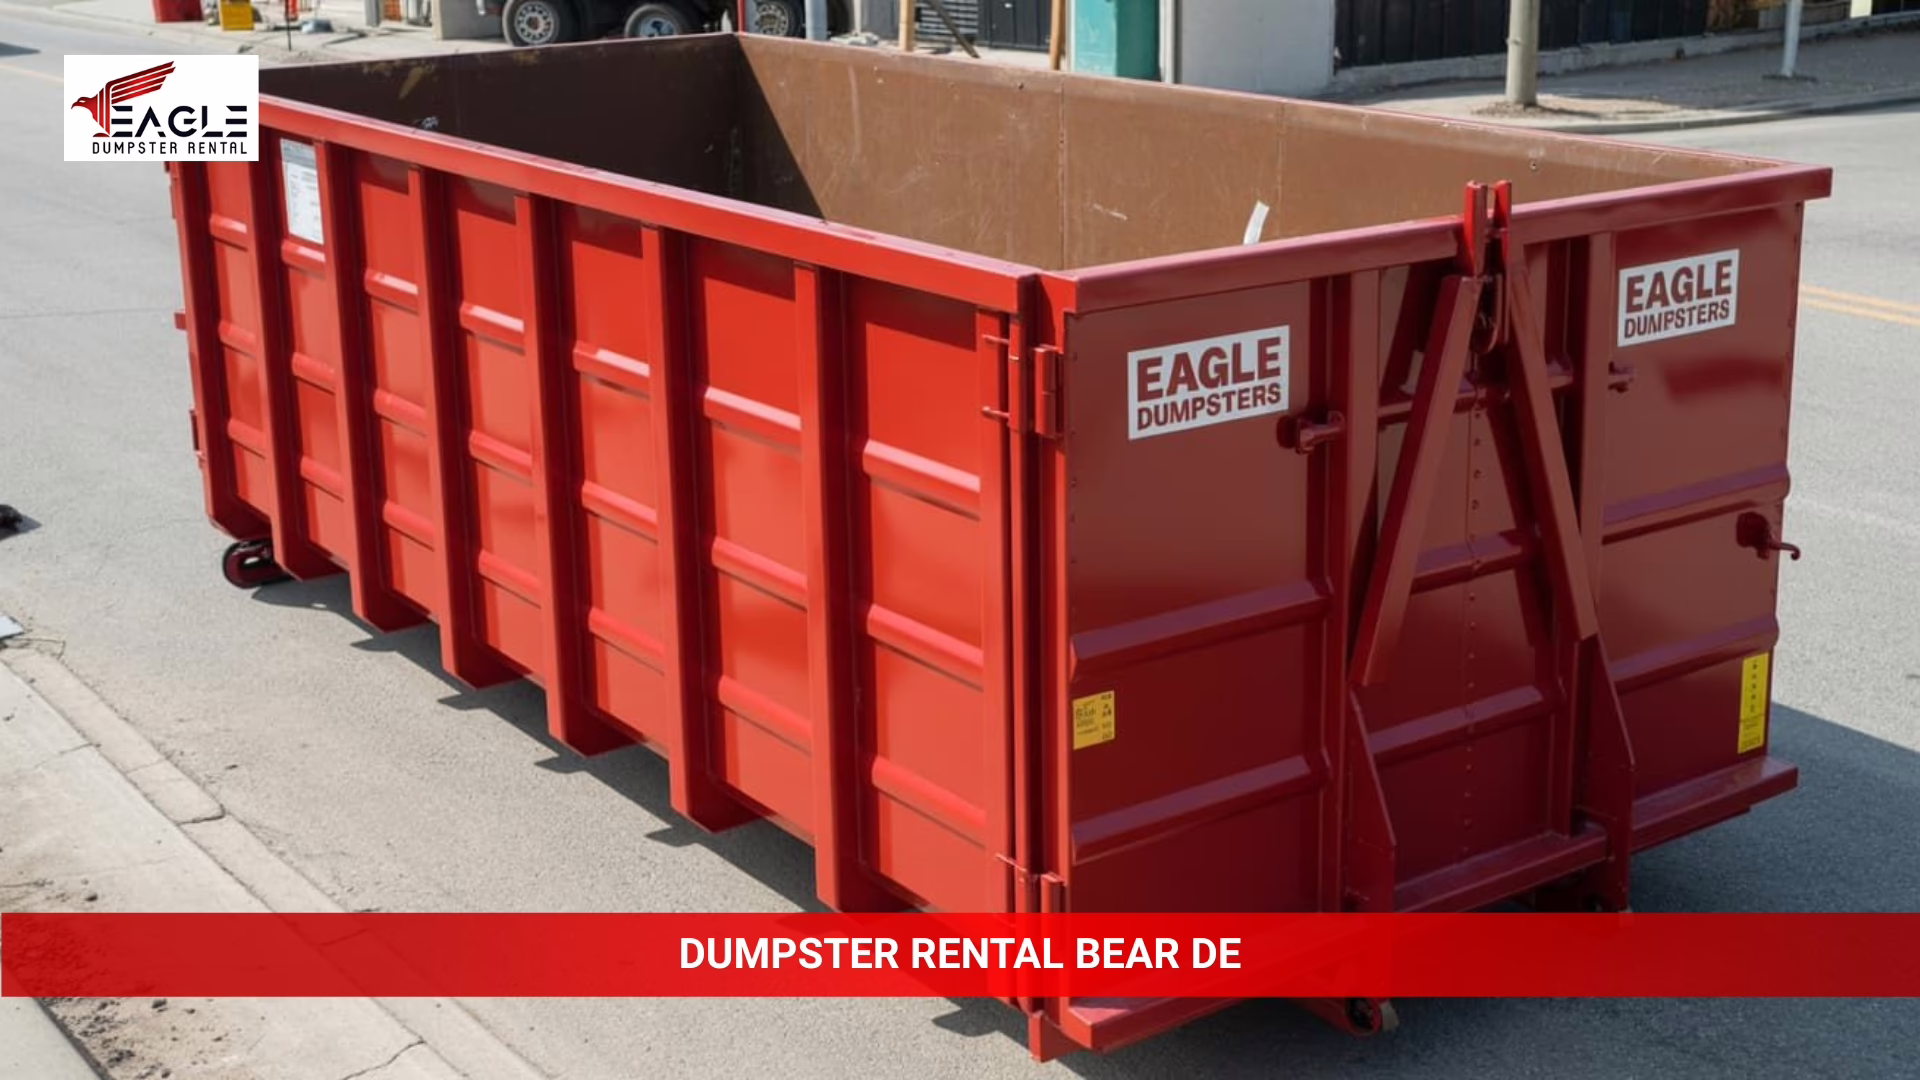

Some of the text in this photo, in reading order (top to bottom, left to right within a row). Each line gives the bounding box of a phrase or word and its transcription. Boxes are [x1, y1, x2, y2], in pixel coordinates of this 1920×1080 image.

[1626, 259, 1732, 314] EAGLE
[1137, 337, 1281, 402] EAGLE
[1137, 383, 1281, 431] DUMPSTERS
